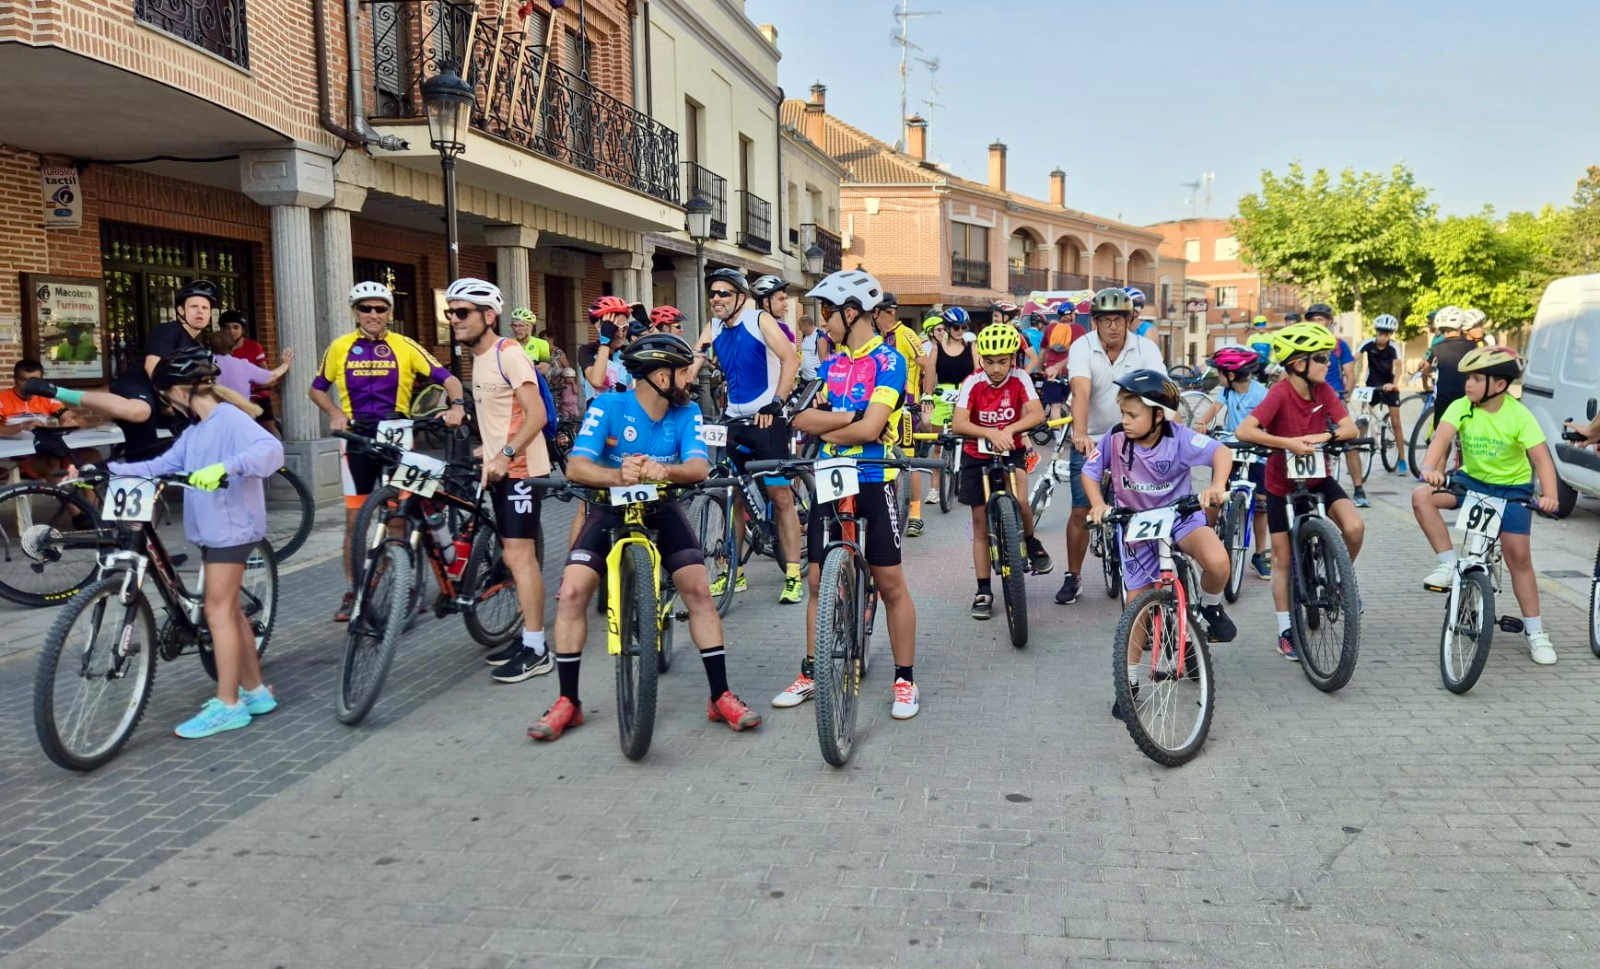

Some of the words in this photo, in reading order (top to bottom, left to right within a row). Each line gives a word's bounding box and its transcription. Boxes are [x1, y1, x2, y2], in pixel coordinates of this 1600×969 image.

[43, 168, 76, 176] TURISMO
[55, 287, 93, 298] Macotera
[57, 300, 94, 311] Turismo
[346, 360, 397, 369] MACOTERA
[1358, 391, 1368, 400] 74
[979, 407, 1016, 423] ERGO
[1294, 453, 1317, 476] 60
[401, 465, 432, 491] 91
[830, 469, 844, 497] 9
[113, 488, 142, 518] 93
[507, 480, 533, 514] sk
[883, 483, 901, 549] ORBEA
[1466, 504, 1497, 532] 97
[1134, 519, 1164, 539] 21
